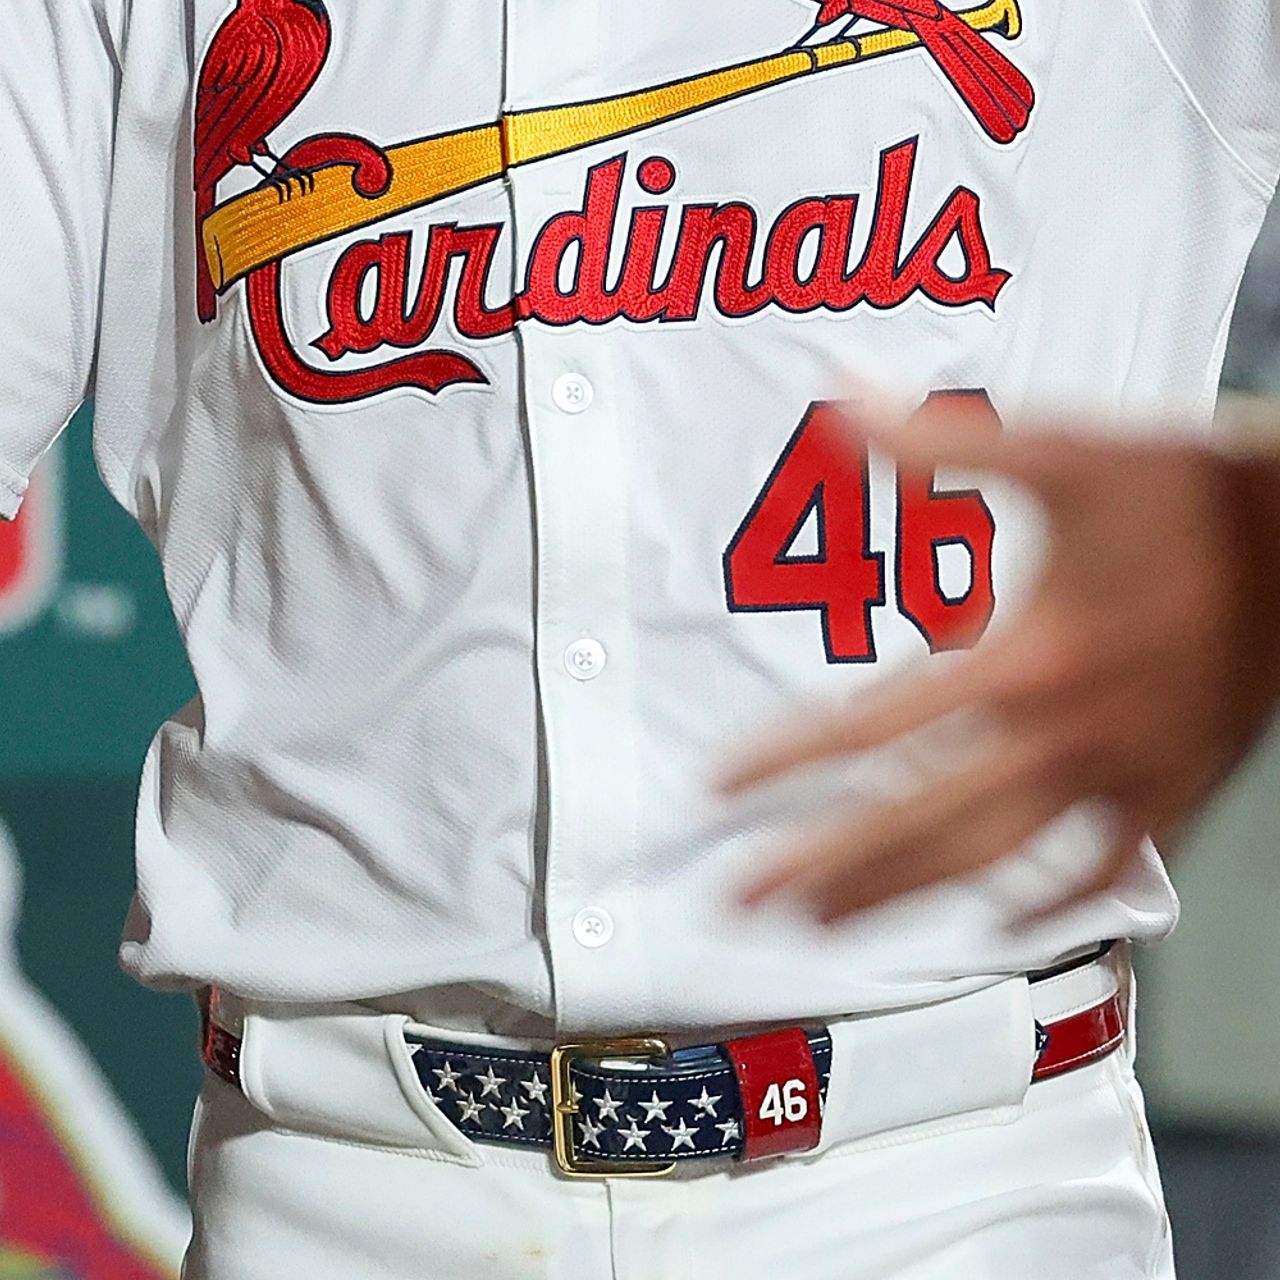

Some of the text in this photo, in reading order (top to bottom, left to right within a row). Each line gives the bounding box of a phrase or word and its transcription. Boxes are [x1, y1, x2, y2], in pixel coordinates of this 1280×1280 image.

[246, 134, 1015, 403] Cardinals
[722, 387, 1004, 664] 46
[759, 1078, 808, 1127] 46
